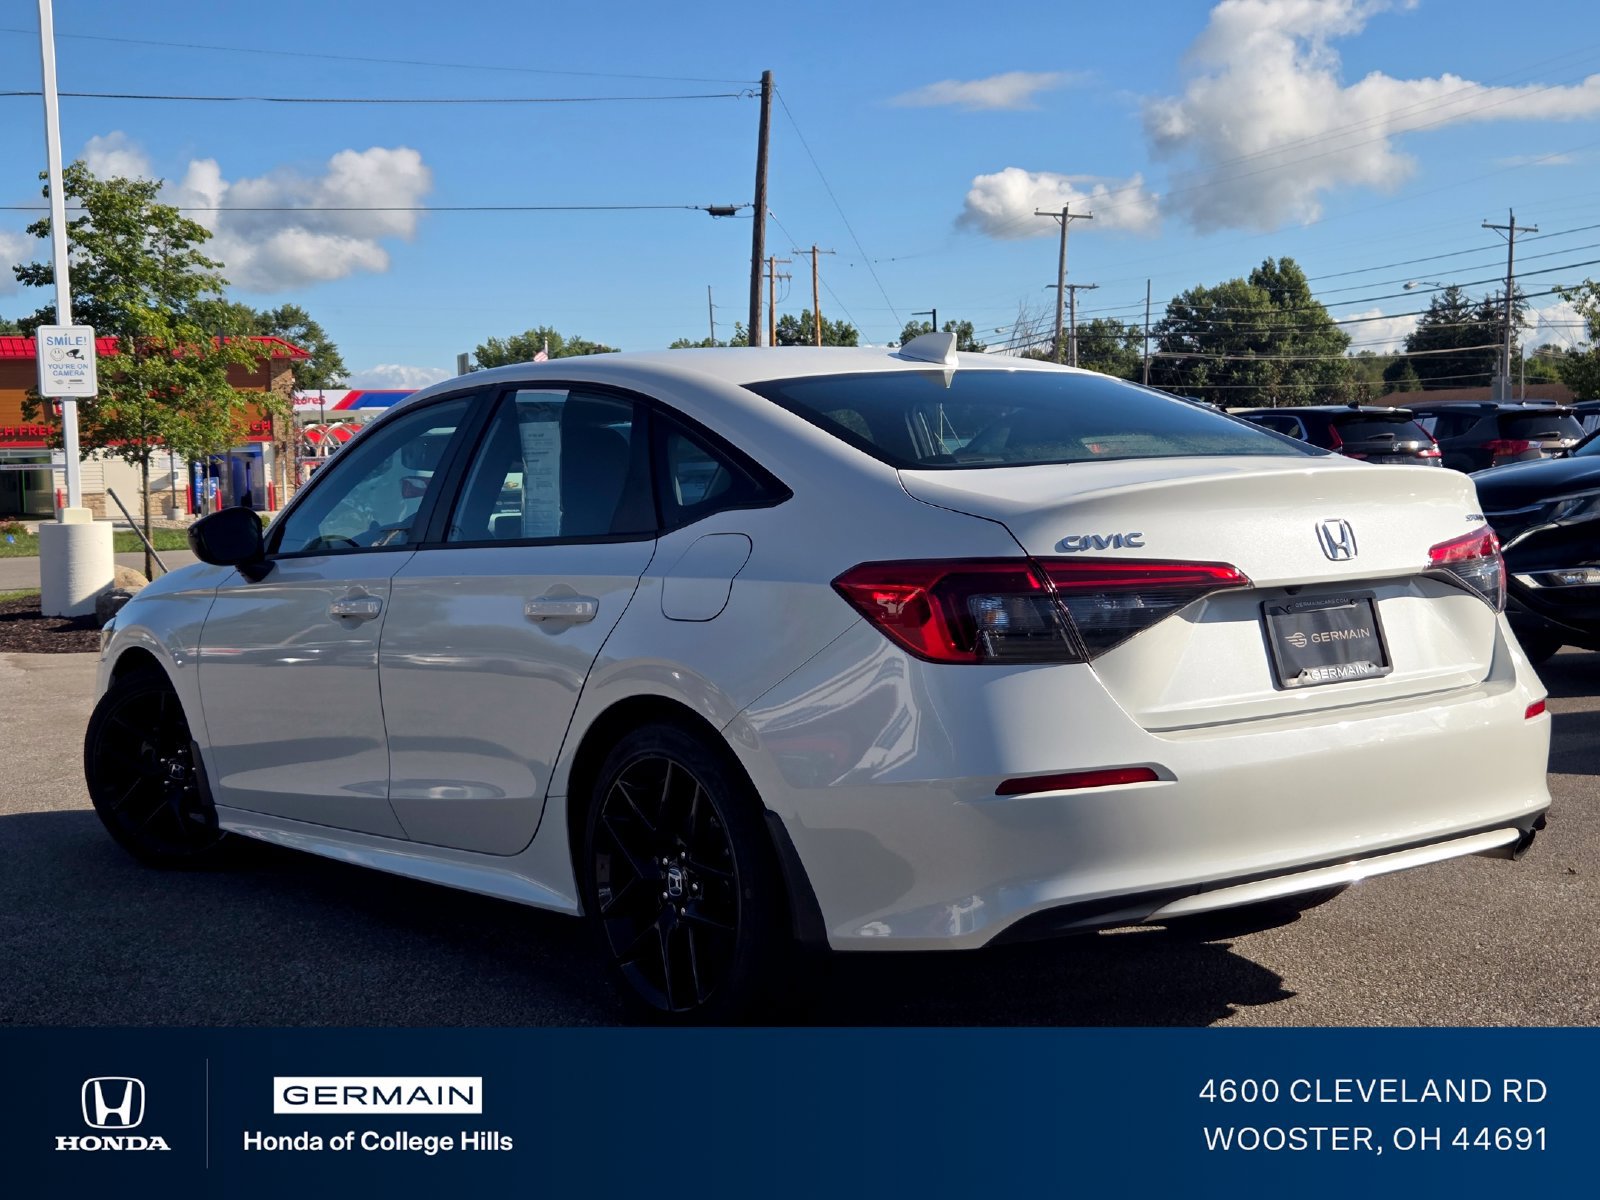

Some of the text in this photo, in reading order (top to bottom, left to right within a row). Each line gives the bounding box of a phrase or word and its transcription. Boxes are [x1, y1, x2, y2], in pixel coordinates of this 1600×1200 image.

[1055, 532, 1145, 553] CIVIC
[1311, 627, 1370, 643] GERMAIN
[1310, 664, 1368, 681] GERMAIN
